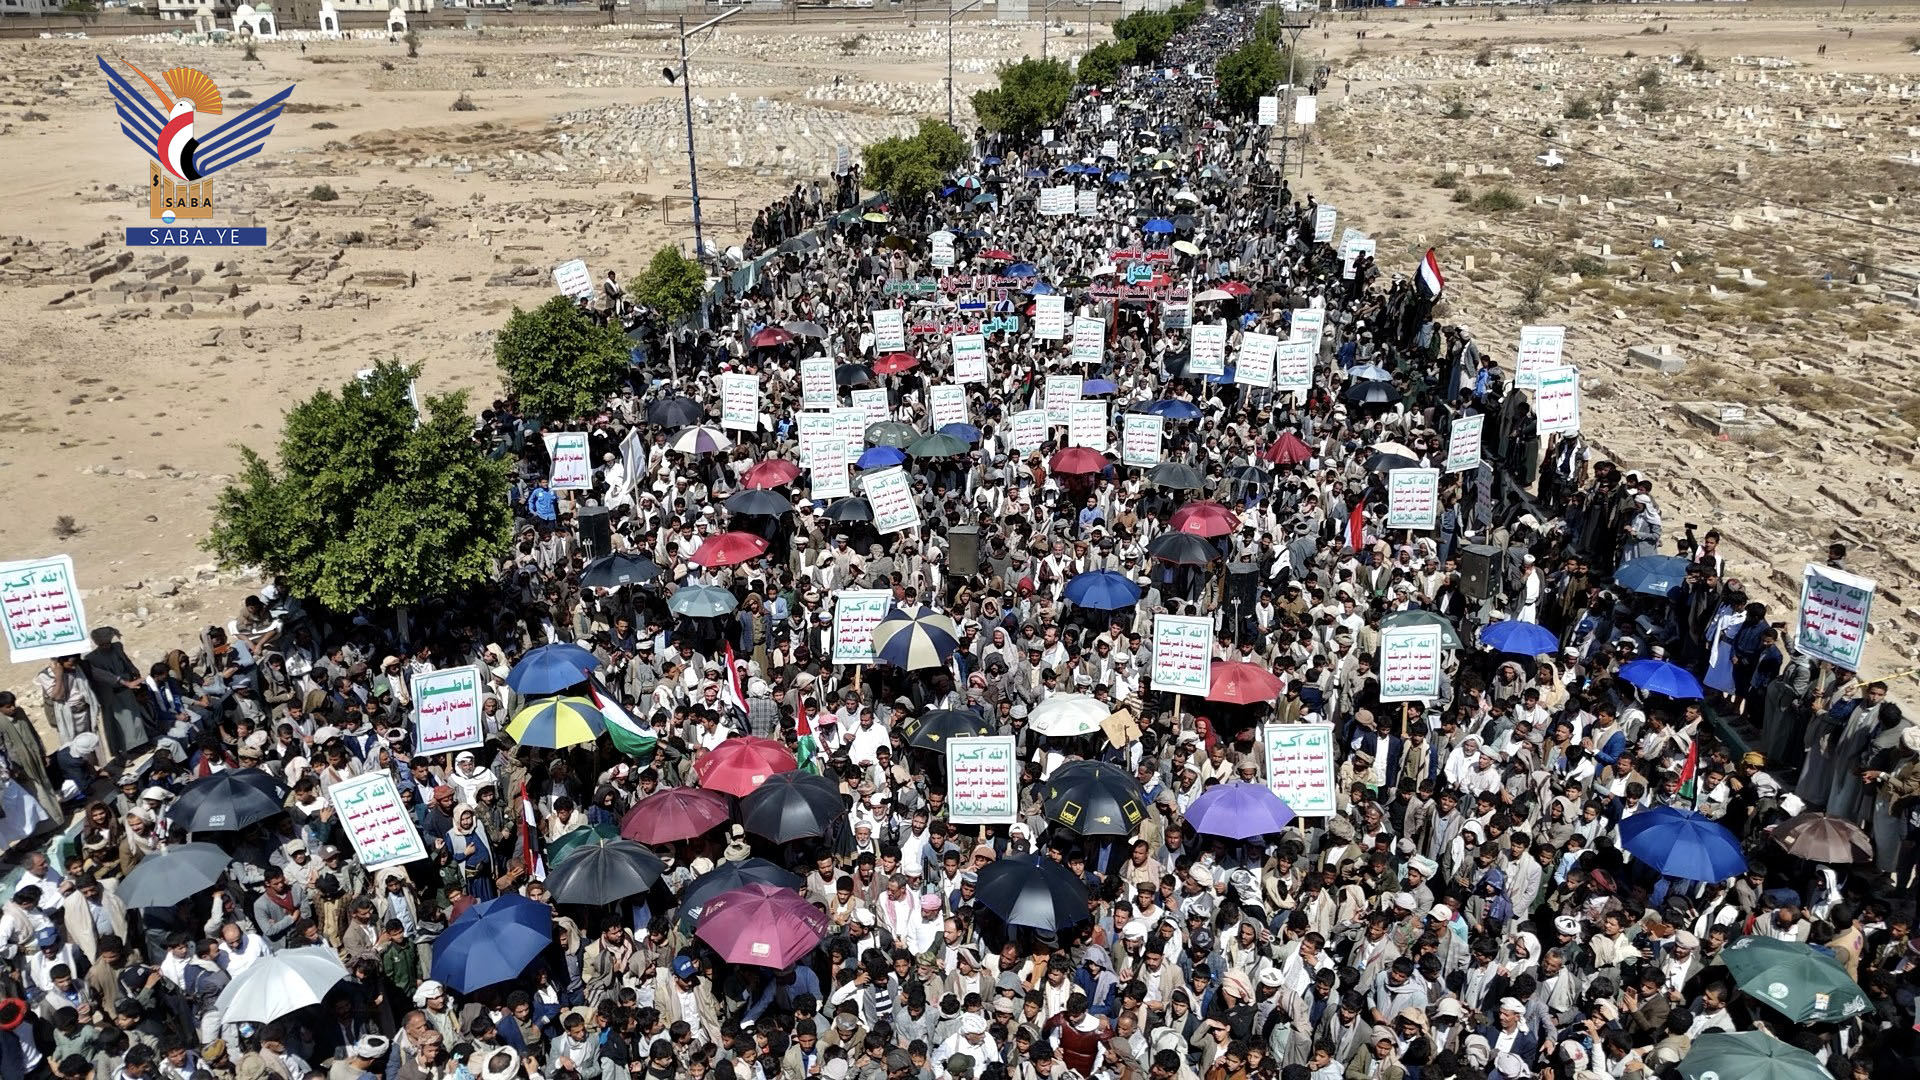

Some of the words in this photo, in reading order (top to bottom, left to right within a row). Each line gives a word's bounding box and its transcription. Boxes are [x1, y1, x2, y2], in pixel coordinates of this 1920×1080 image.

[41, 570, 63, 583] الله
[1847, 587, 1869, 601] الله
[1189, 628, 1206, 637] الله
[1417, 638, 1435, 647] الله
[420, 676, 473, 699] قاطعوا
[450, 698, 473, 712] البضائع
[988, 748, 1008, 759] الله
[372, 783, 390, 797] الله
